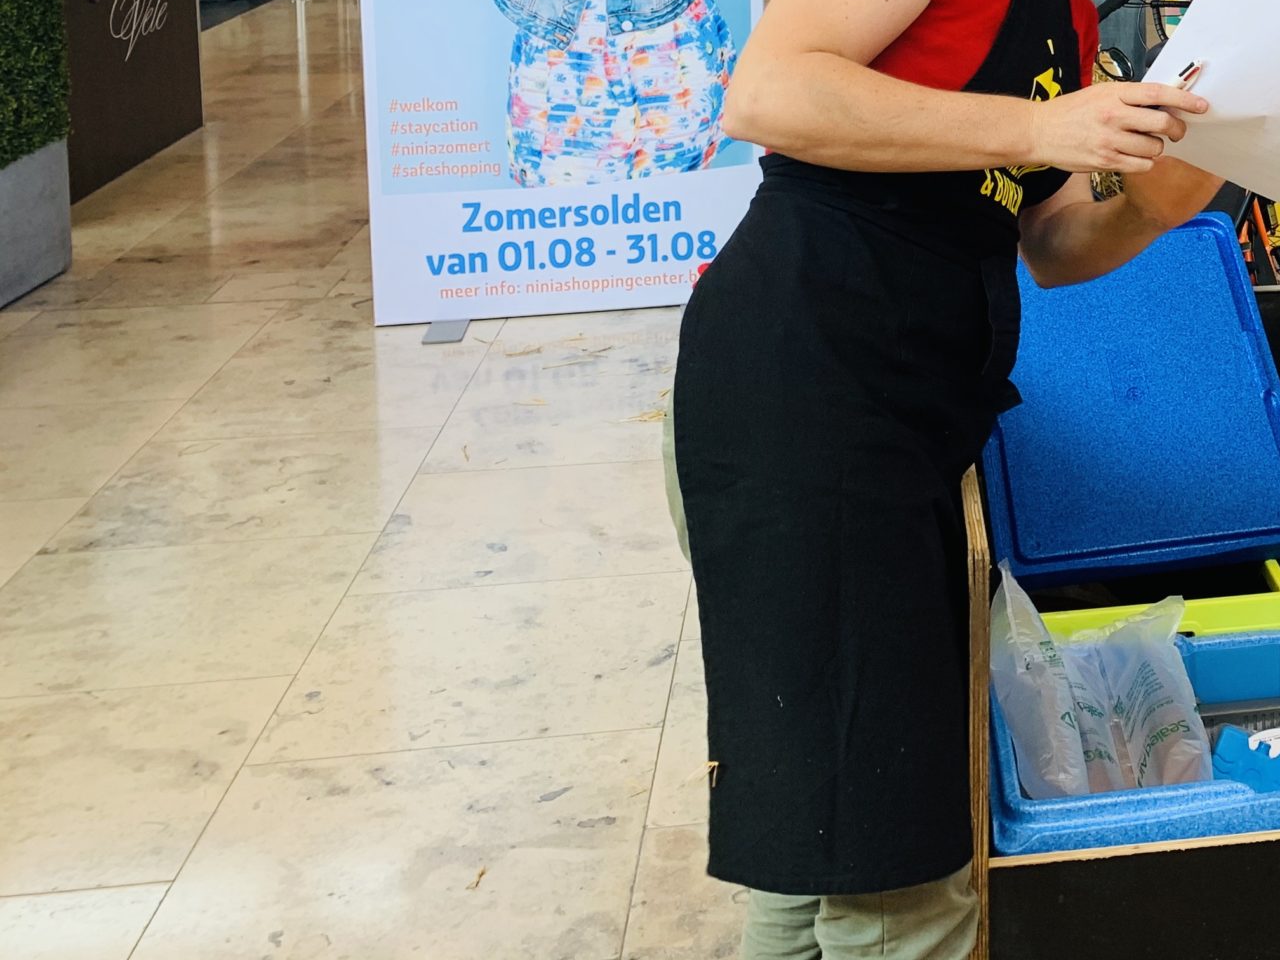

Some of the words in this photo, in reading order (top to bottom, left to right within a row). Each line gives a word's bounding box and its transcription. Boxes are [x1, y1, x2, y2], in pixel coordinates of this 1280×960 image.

[389, 97, 459, 113] #welkom
[390, 119, 478, 137] #staycation
[391, 141, 491, 157] #niniazomert
[392, 160, 501, 179] #safeshopping
[461, 192, 682, 233] Zomersolden
[425, 251, 488, 276] van
[498, 236, 597, 272] 01.08
[626, 230, 717, 265] 31.08
[440, 285, 478, 299] meer
[485, 279, 521, 297] info:
[526, 269, 698, 294] niniashoppingcenter.b
